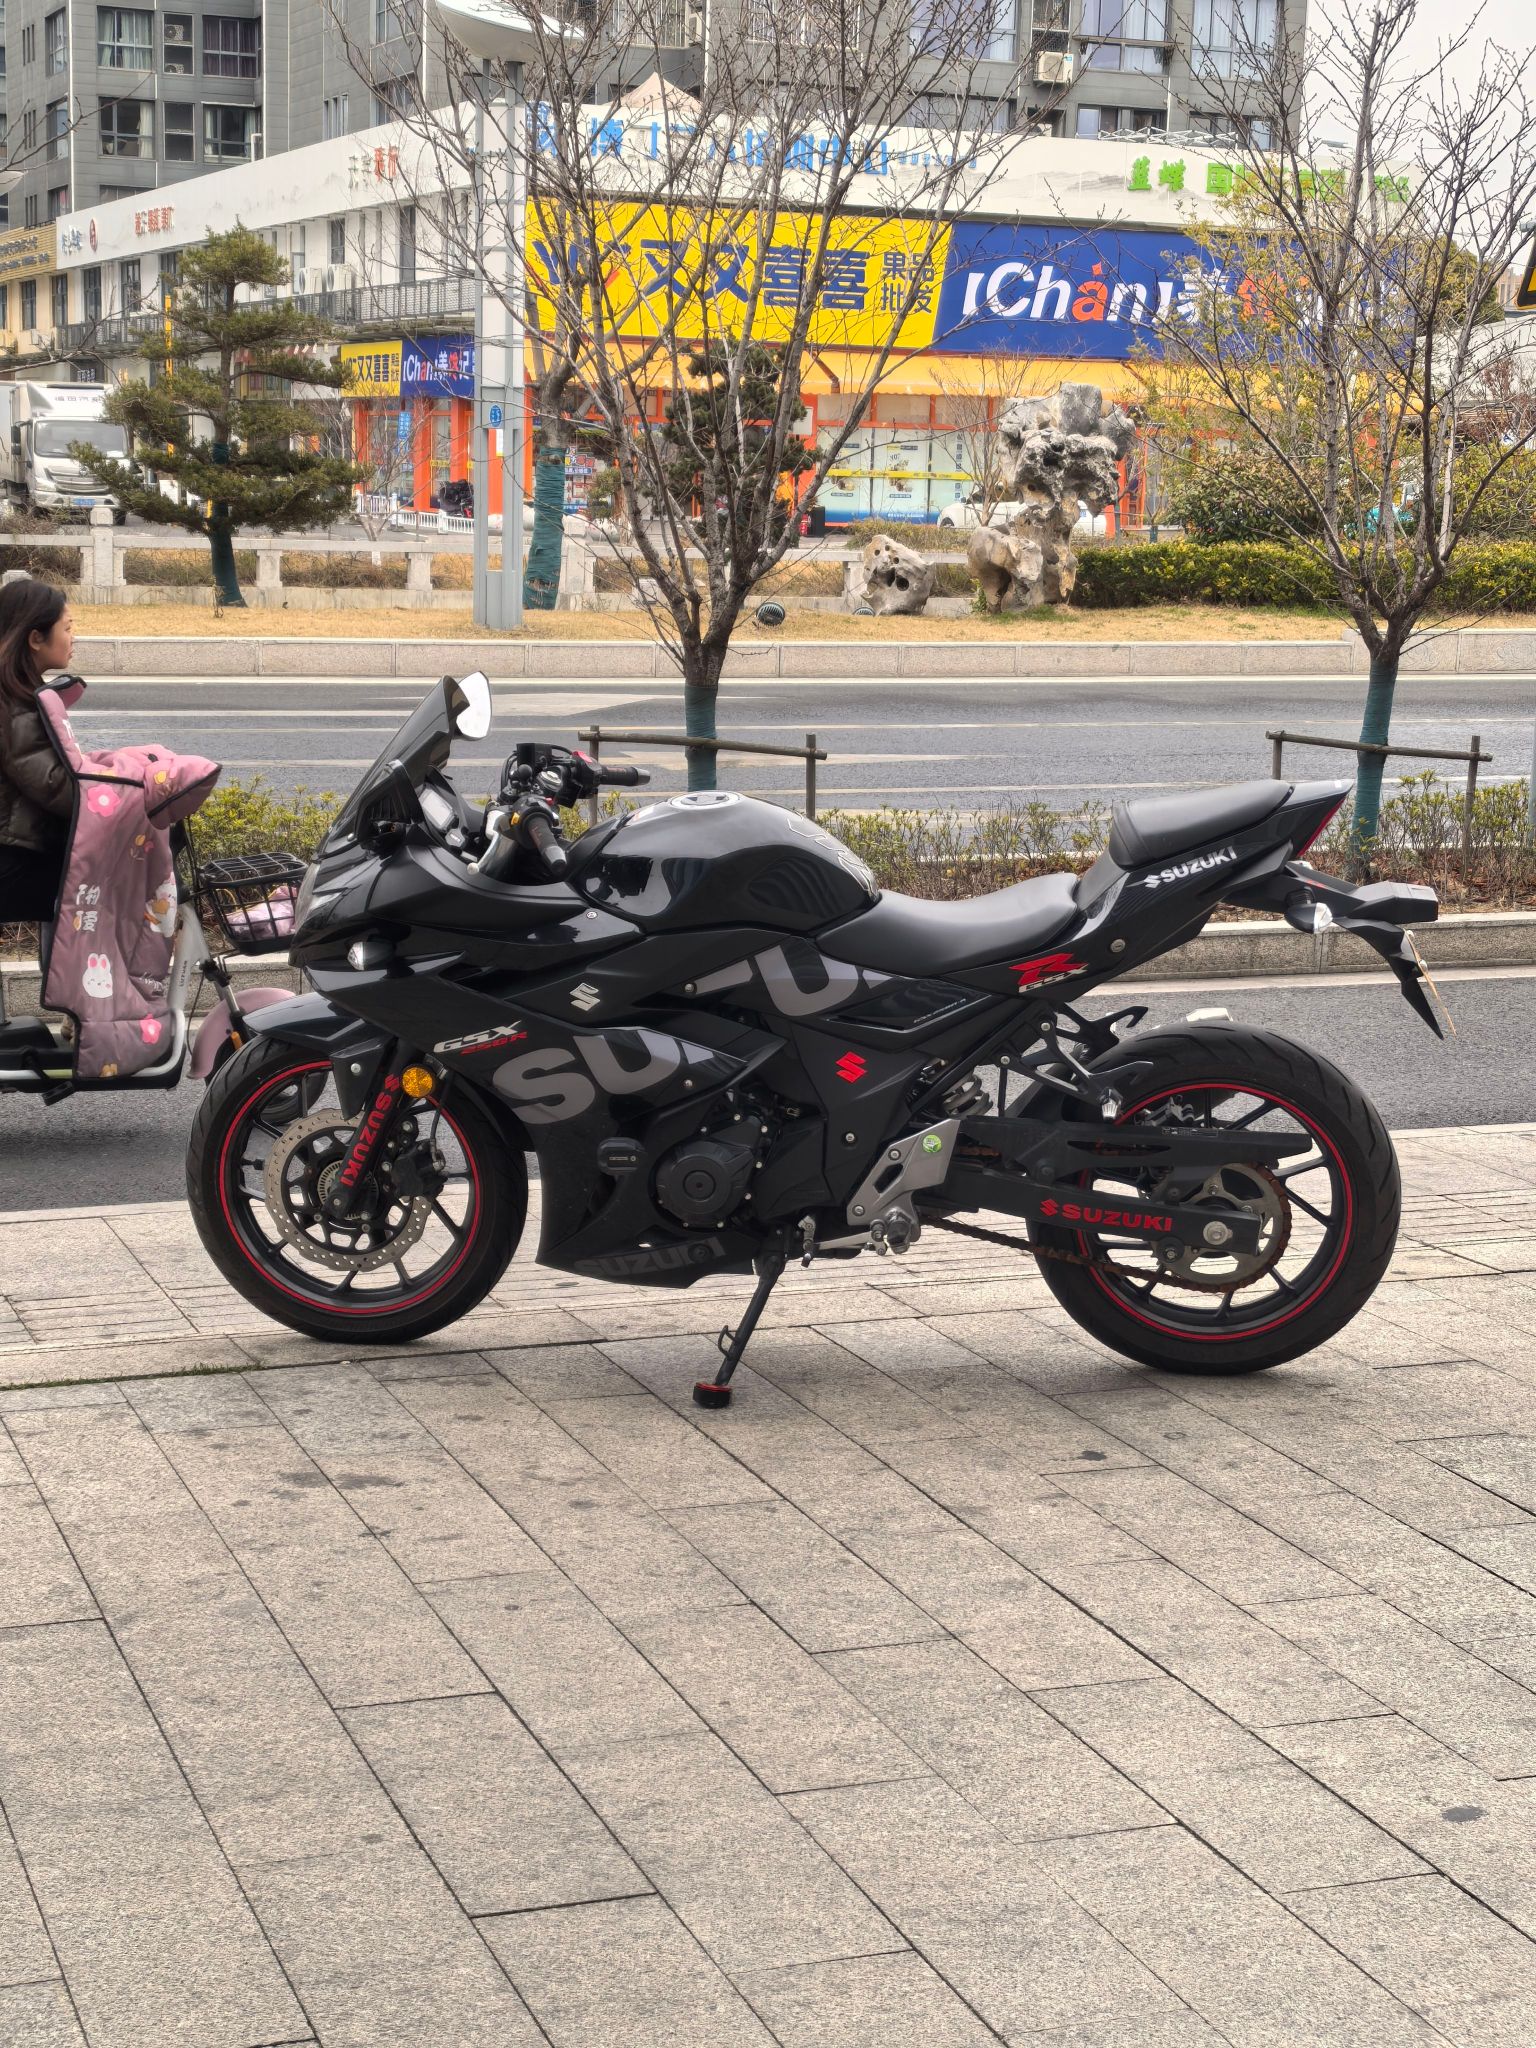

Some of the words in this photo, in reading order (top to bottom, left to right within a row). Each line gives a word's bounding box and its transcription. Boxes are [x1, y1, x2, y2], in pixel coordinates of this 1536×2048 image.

[882, 251, 935, 282] 果品
[880, 282, 935, 314] 批发
[1160, 846, 1238, 883] SUZUKI
[433, 1020, 522, 1053] GSX
[340, 1092, 393, 1187] SUZUKI
[1061, 1203, 1174, 1232] SUZUKI
